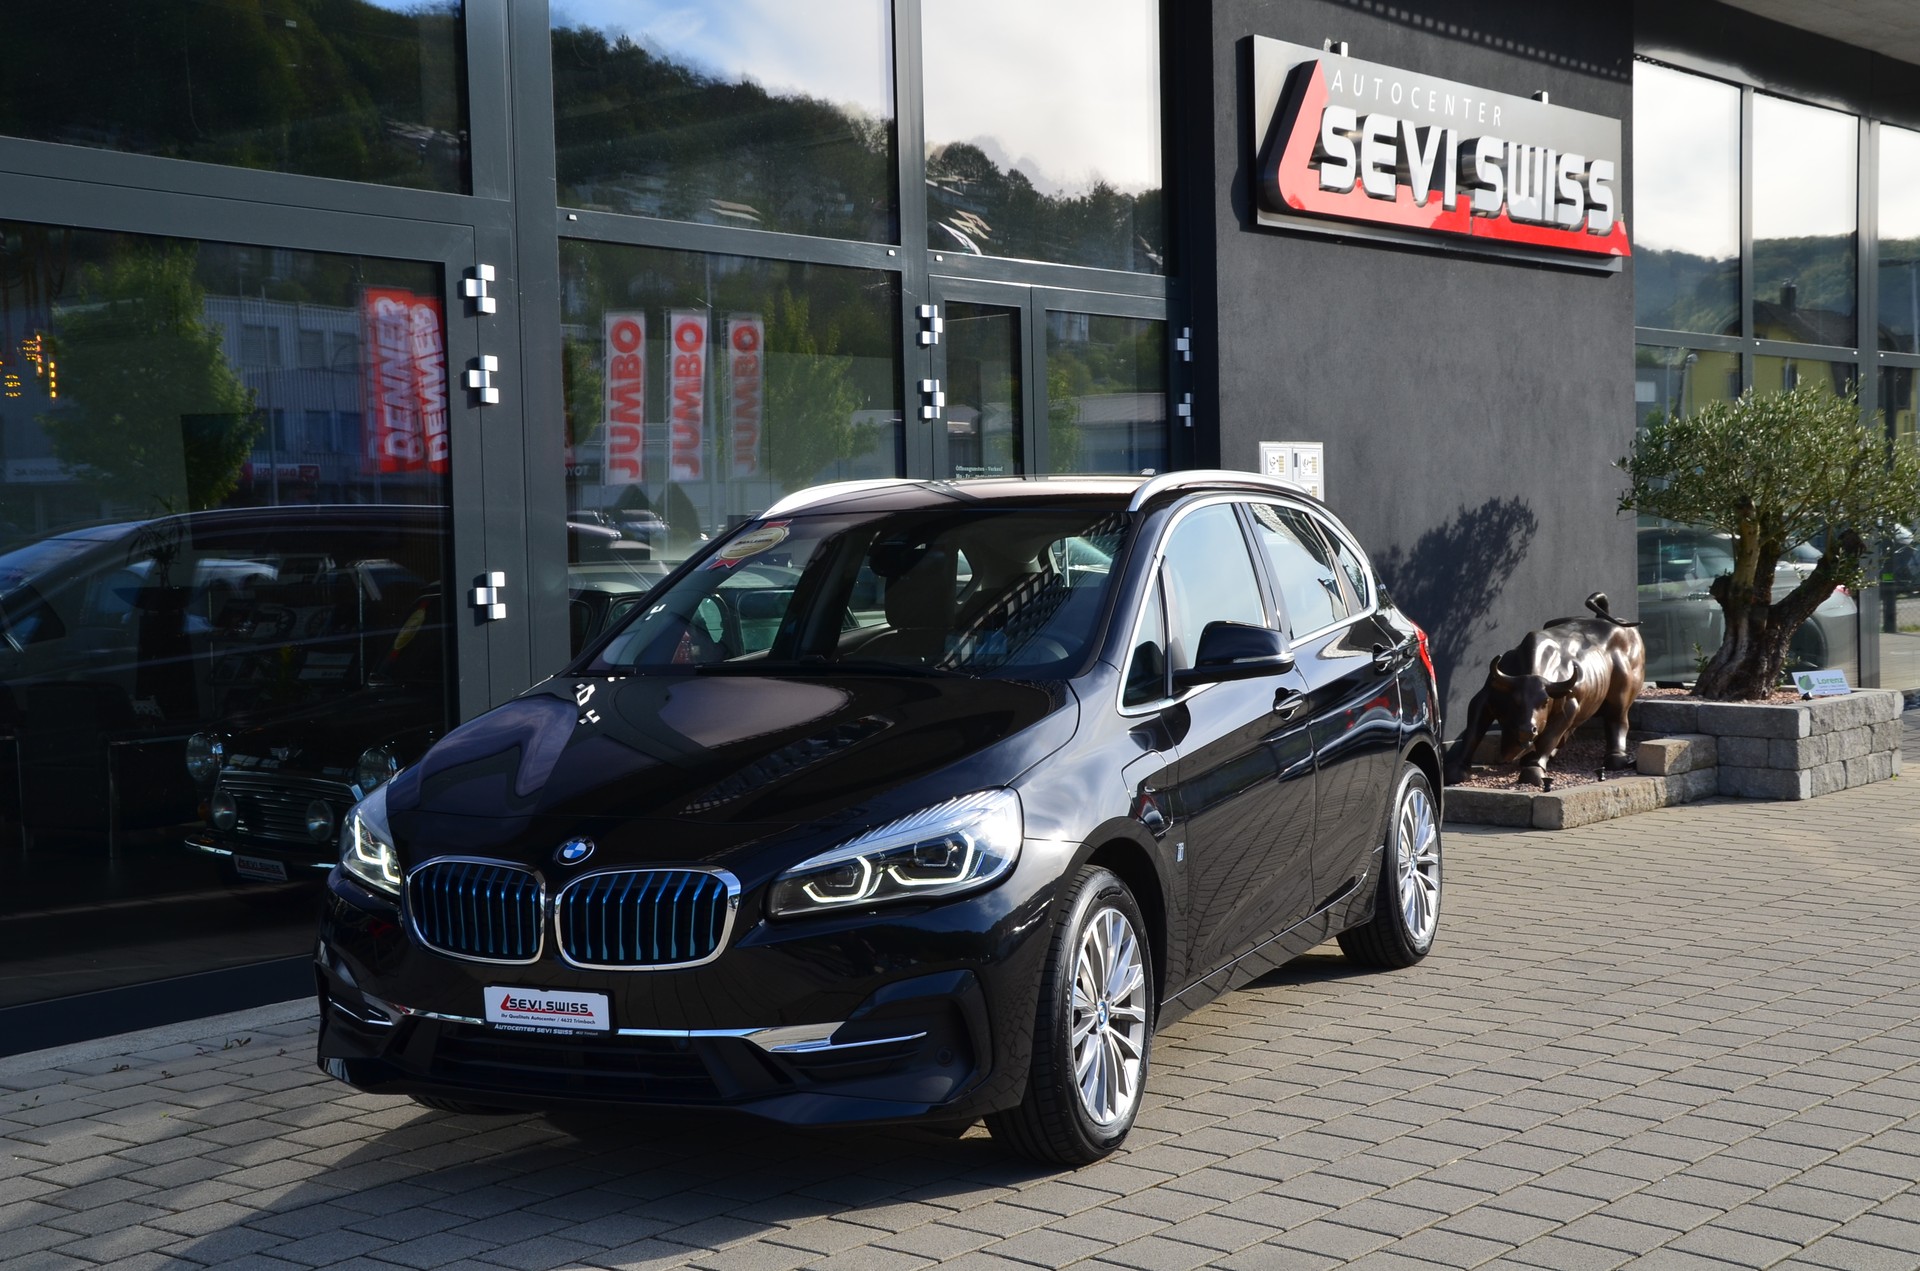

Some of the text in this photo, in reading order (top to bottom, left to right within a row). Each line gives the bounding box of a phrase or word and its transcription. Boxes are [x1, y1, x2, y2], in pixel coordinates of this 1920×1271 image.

[1331, 68, 1502, 127] AUTOCENTER
[1319, 105, 1615, 236] SEVI SWISS
[609, 320, 642, 479] JUMBO
[672, 322, 704, 478] JUMBO
[732, 325, 760, 473] JUMBO
[509, 998, 589, 1013] SEVI SWISS
